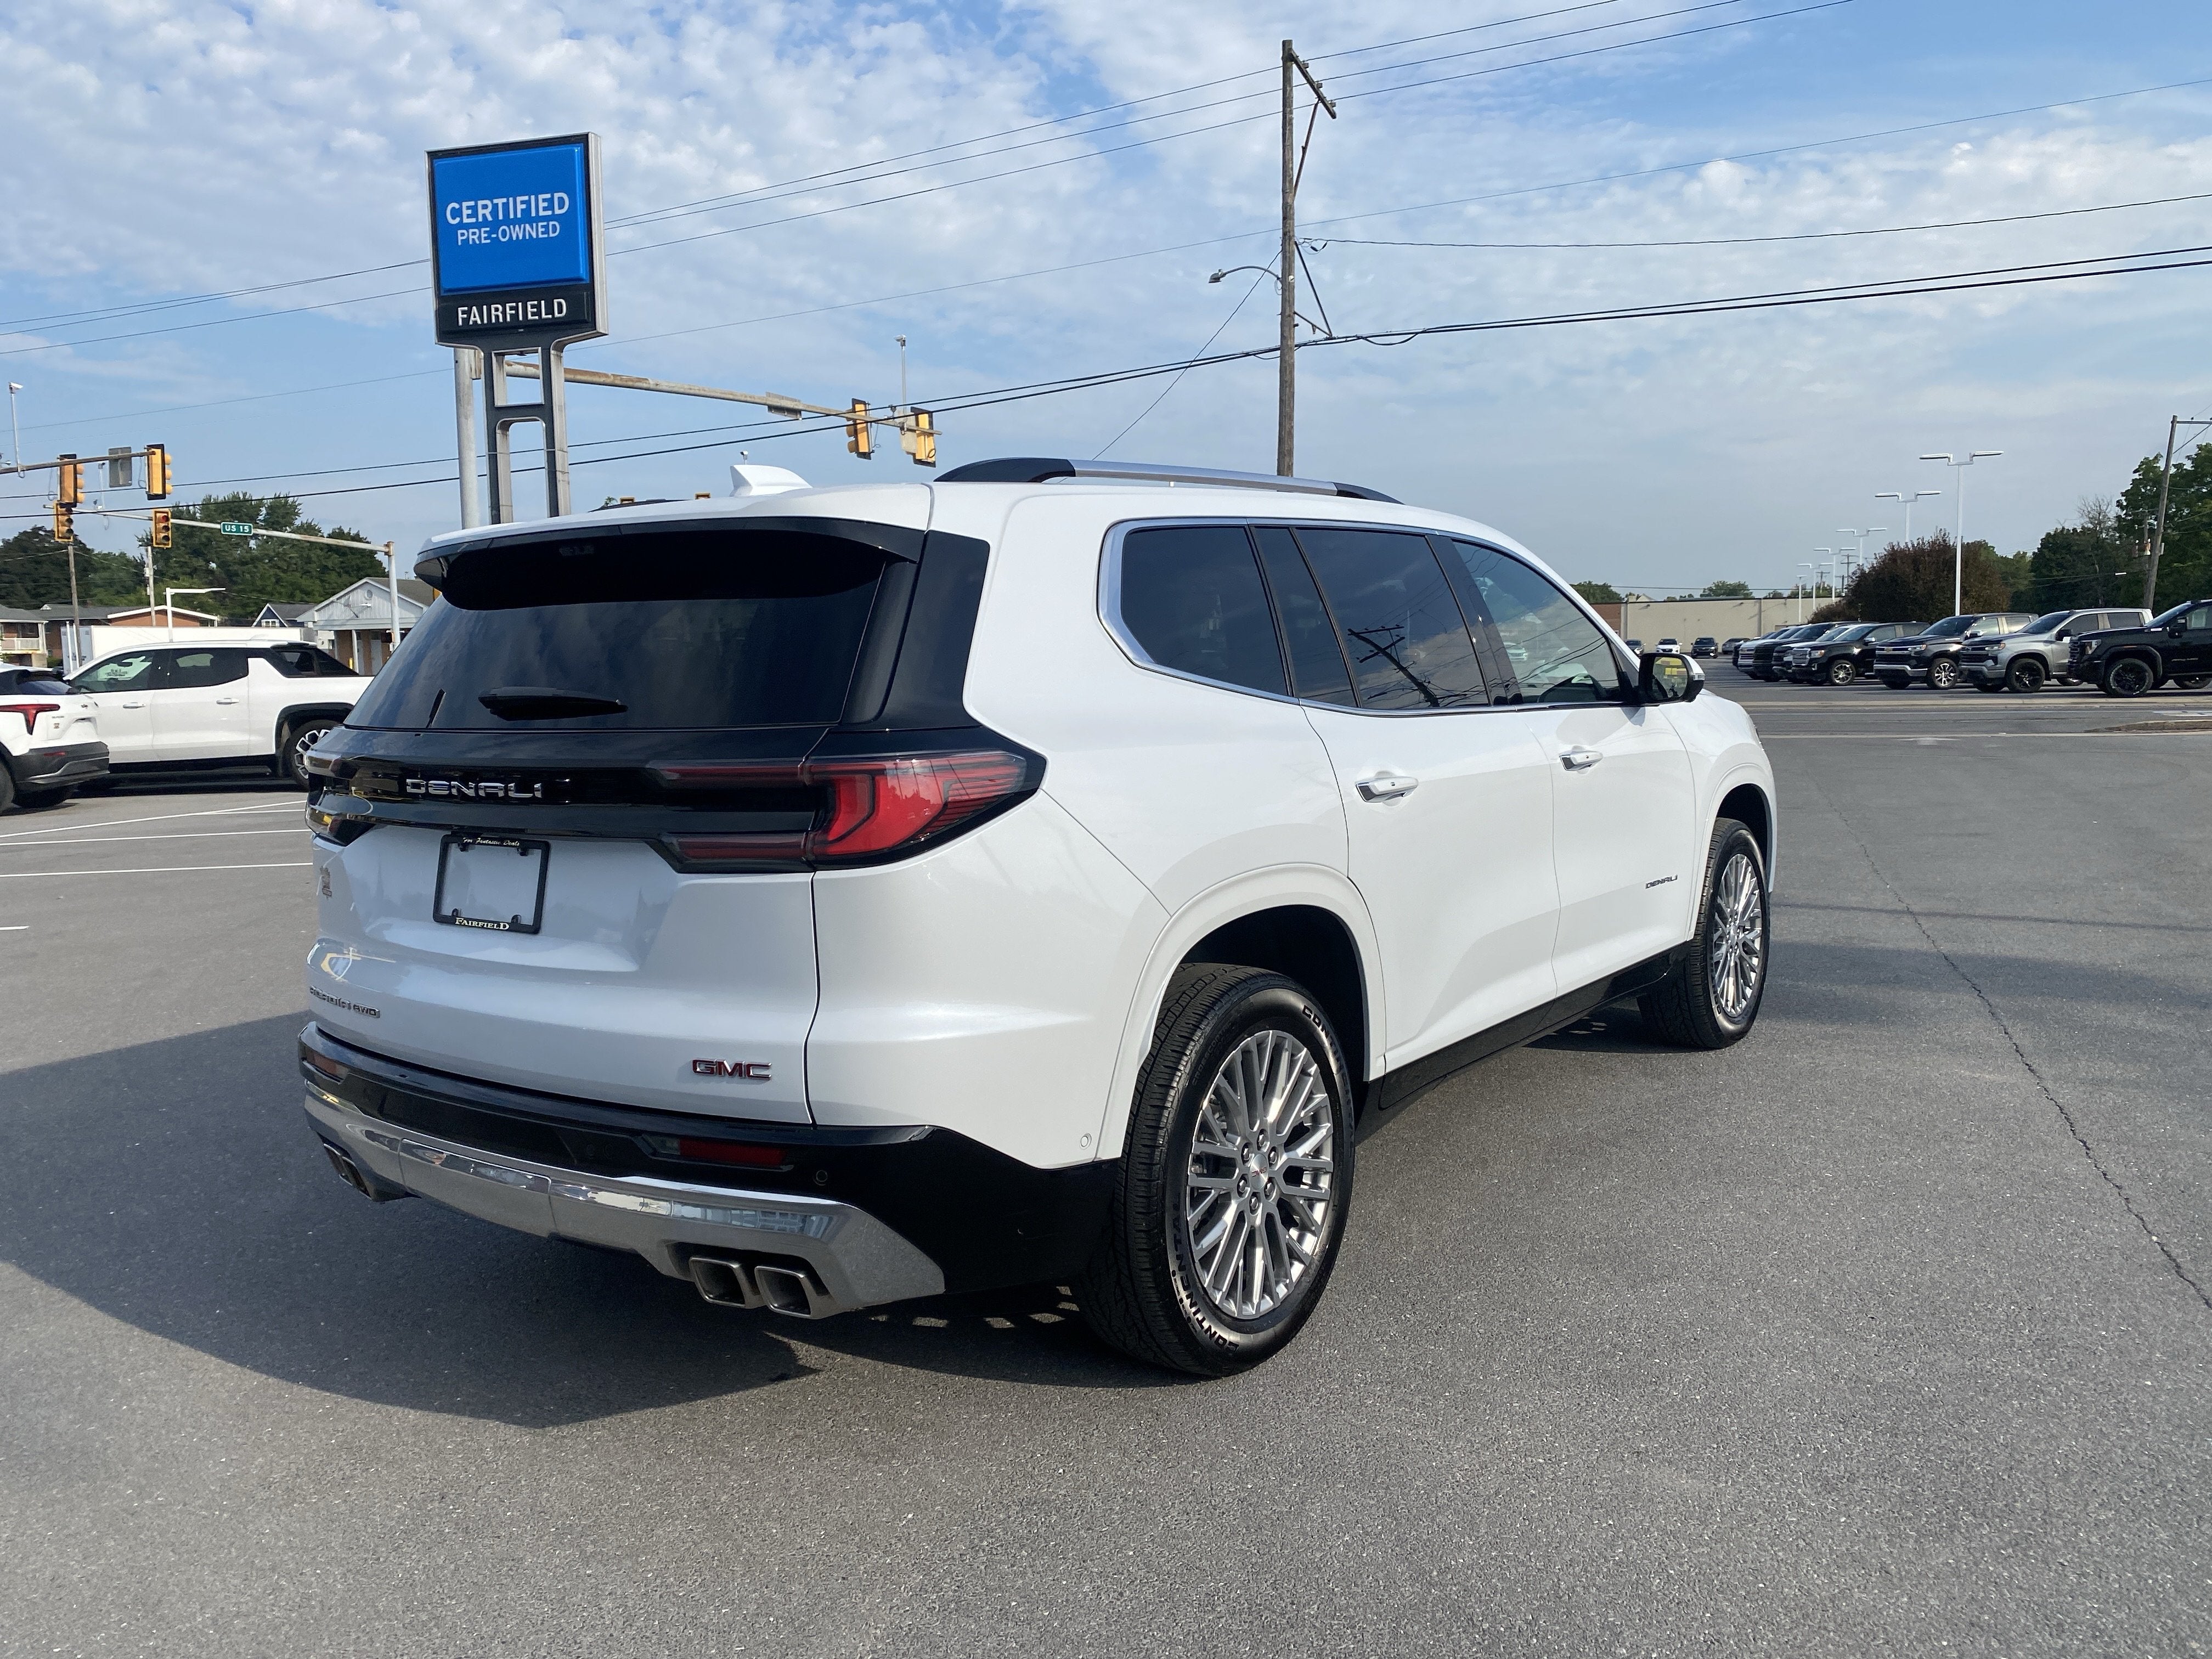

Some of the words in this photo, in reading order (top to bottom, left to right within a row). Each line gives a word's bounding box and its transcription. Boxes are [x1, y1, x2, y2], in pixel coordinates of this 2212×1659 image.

[445, 192, 569, 225] CERTIFIED
[457, 221, 560, 245] PRE-OWNED
[458, 298, 567, 326] FAIRFIELD
[406, 779, 543, 798] DENALI
[1645, 874, 1678, 889] DENALI
[455, 917, 510, 930] FAIRFIELD
[353, 1003, 381, 1019] AWD
[692, 1058, 772, 1081] GMC
[1172, 1192, 1239, 1352] CONTINENTAL
